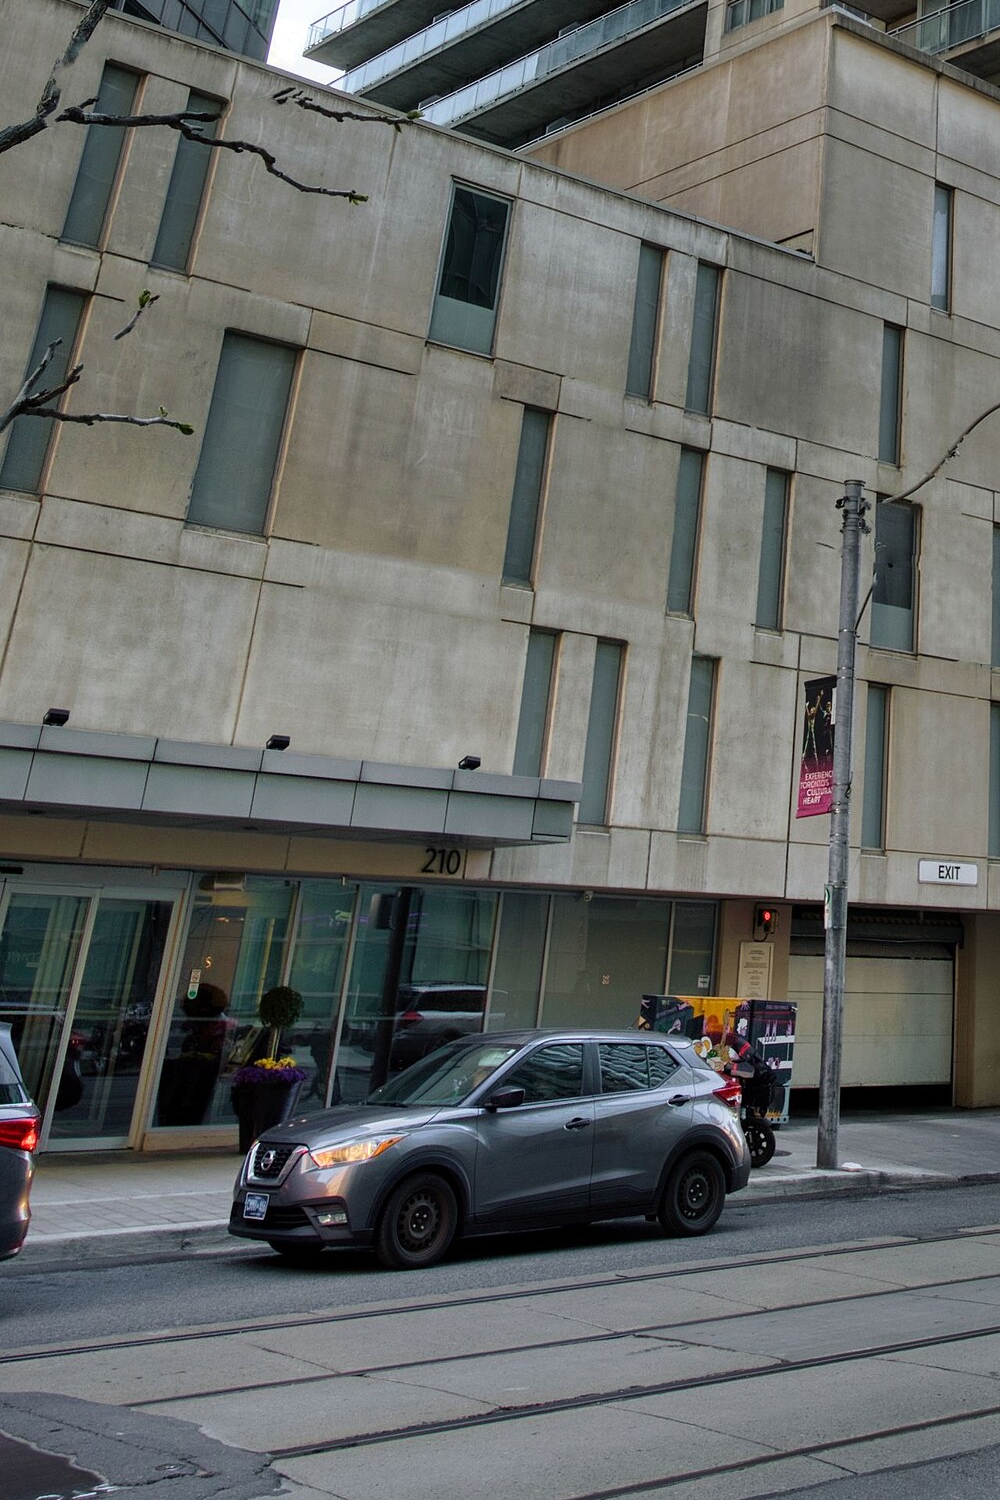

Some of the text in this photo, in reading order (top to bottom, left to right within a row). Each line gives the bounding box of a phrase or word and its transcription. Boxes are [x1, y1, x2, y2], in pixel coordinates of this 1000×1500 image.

[805, 771, 834, 781] EXPERIENC
[800, 779, 829, 789] TORONTO'S
[806, 787, 834, 797] CULTURA
[803, 796, 821, 805] HEART
[421, 848, 461, 875] 210
[938, 865, 961, 880] EXIT
